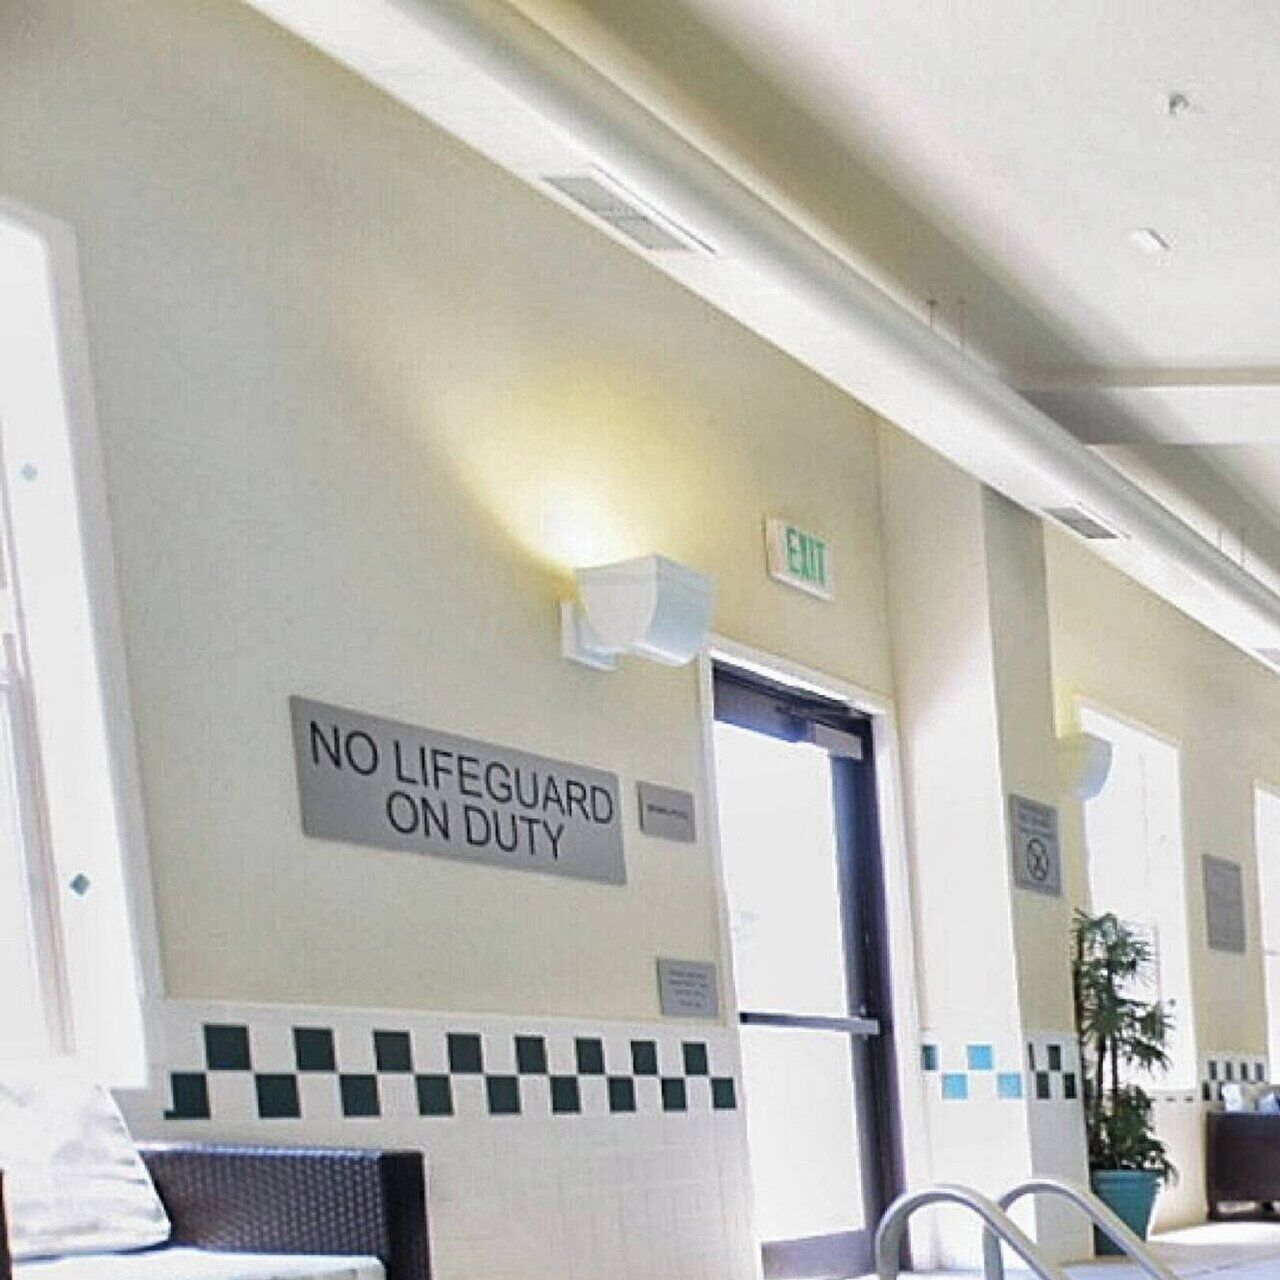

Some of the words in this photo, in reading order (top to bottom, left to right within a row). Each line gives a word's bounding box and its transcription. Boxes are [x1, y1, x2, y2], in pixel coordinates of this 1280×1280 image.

[785, 526, 826, 588] EXIT
[310, 720, 379, 777] NO
[394, 739, 613, 824] LIFEGUARD
[387, 790, 449, 841] ON
[464, 803, 565, 862] DUTY
